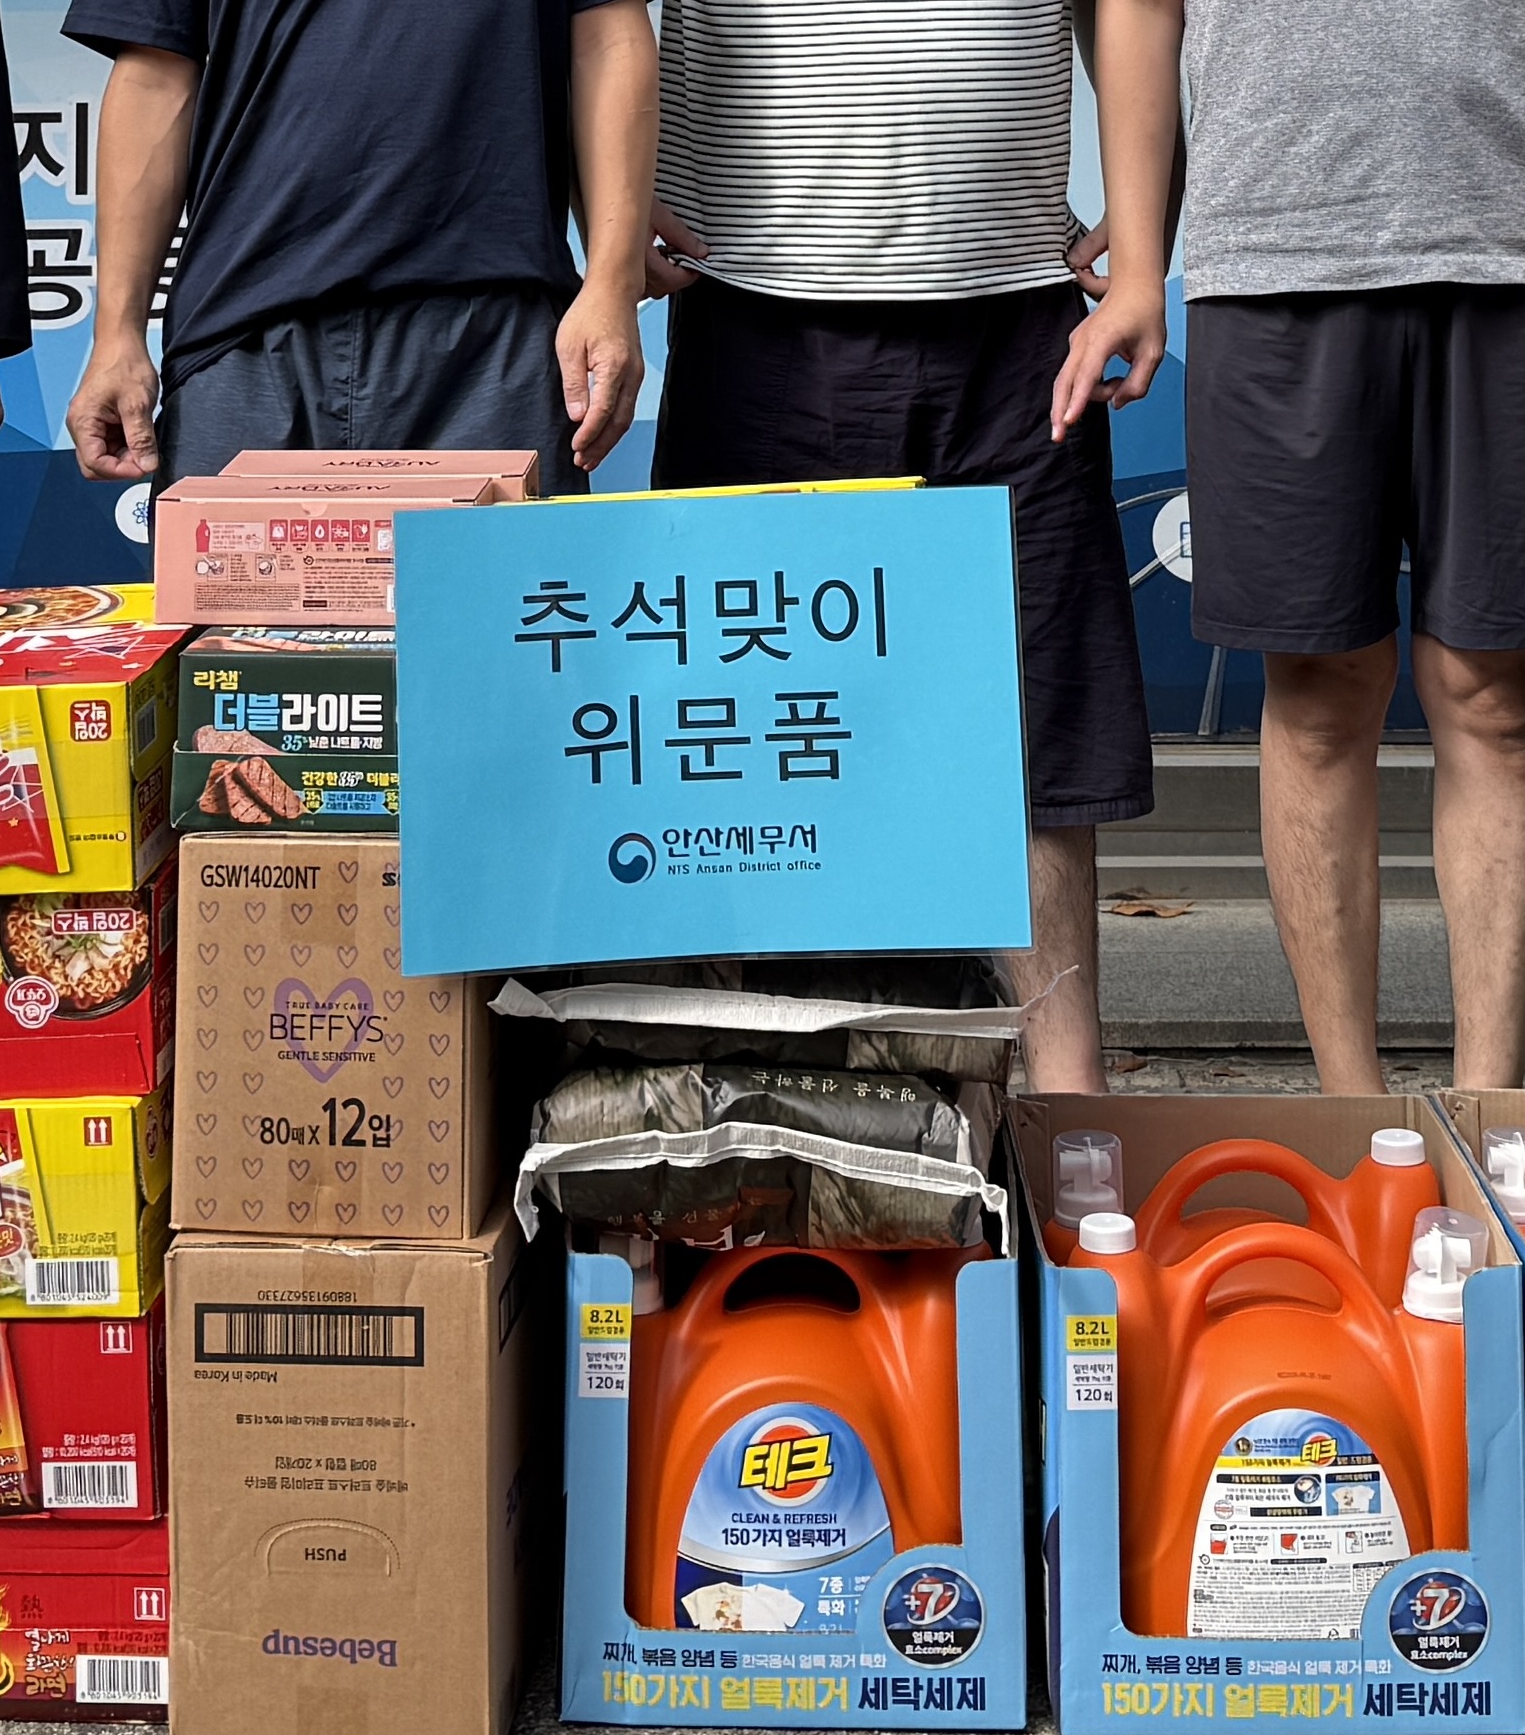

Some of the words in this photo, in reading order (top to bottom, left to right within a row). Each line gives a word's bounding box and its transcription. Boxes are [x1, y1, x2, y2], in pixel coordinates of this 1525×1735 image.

[514, 567, 887, 673] 추석맞이
[193, 670, 239, 690] 리챔
[74, 702, 108, 722] 박스
[214, 693, 384, 732] 더블라이트
[73, 722, 108, 741] 20입
[564, 691, 852, 785] 위문품
[662, 824, 816, 857] 안산세무서
[201, 864, 321, 890] GSW14020NT
[668, 864, 689, 875] NTS
[697, 864, 732, 874] Ansan
[739, 862, 780, 872] District
[787, 860, 821, 870] office
[56, 914, 89, 932] 박스
[92, 912, 130, 931] 20입
[16, 988, 47, 1003] 오뚜기
[270, 1013, 385, 1043] BEFFYS
[278, 1050, 320, 1062] GENTLE
[322, 1051, 376, 1062] SENSITIVE
[590, 1309, 624, 1323] 8.2L
[1076, 1321, 1109, 1335] 8.2L
[194, 1369, 229, 1382] Korea
[232, 1371, 243, 1382] in
[245, 1371, 278, 1383] Made
[1300, 1437, 1338, 1463] 테크
[738, 1432, 834, 1490] 테크
[731, 1513, 769, 1524] CLEAN
[774, 1513, 780, 1524] &
[784, 1513, 837, 1524] REFRESH
[721, 1527, 782, 1547] 150가지
[786, 1528, 846, 1547] 얼룩제거
[305, 1548, 347, 1562] PUSH
[262, 1628, 398, 1667] Bebesup
[602, 1641, 637, 1664] 찌개,
[642, 1647, 676, 1668] 볶음
[681, 1648, 715, 1668] 양념
[720, 1650, 738, 1669] 등
[829, 1653, 856, 1668] 제거
[1102, 1654, 1141, 1675] 찌개,
[1146, 1655, 1181, 1675] 볶음
[1185, 1655, 1220, 1675] 양념
[1225, 1656, 1243, 1675] 등
[1335, 1659, 1361, 1675] 제거
[26, 1672, 67, 1698] 라면
[602, 1671, 710, 1710] 150가지
[720, 1675, 849, 1711] 얼룩제거
[858, 1677, 986, 1711] 세탁세제
[1101, 1682, 1214, 1717] 150가지
[1224, 1683, 1354, 1718] 얼룩제거
[1363, 1681, 1491, 1717] 세탁세제
